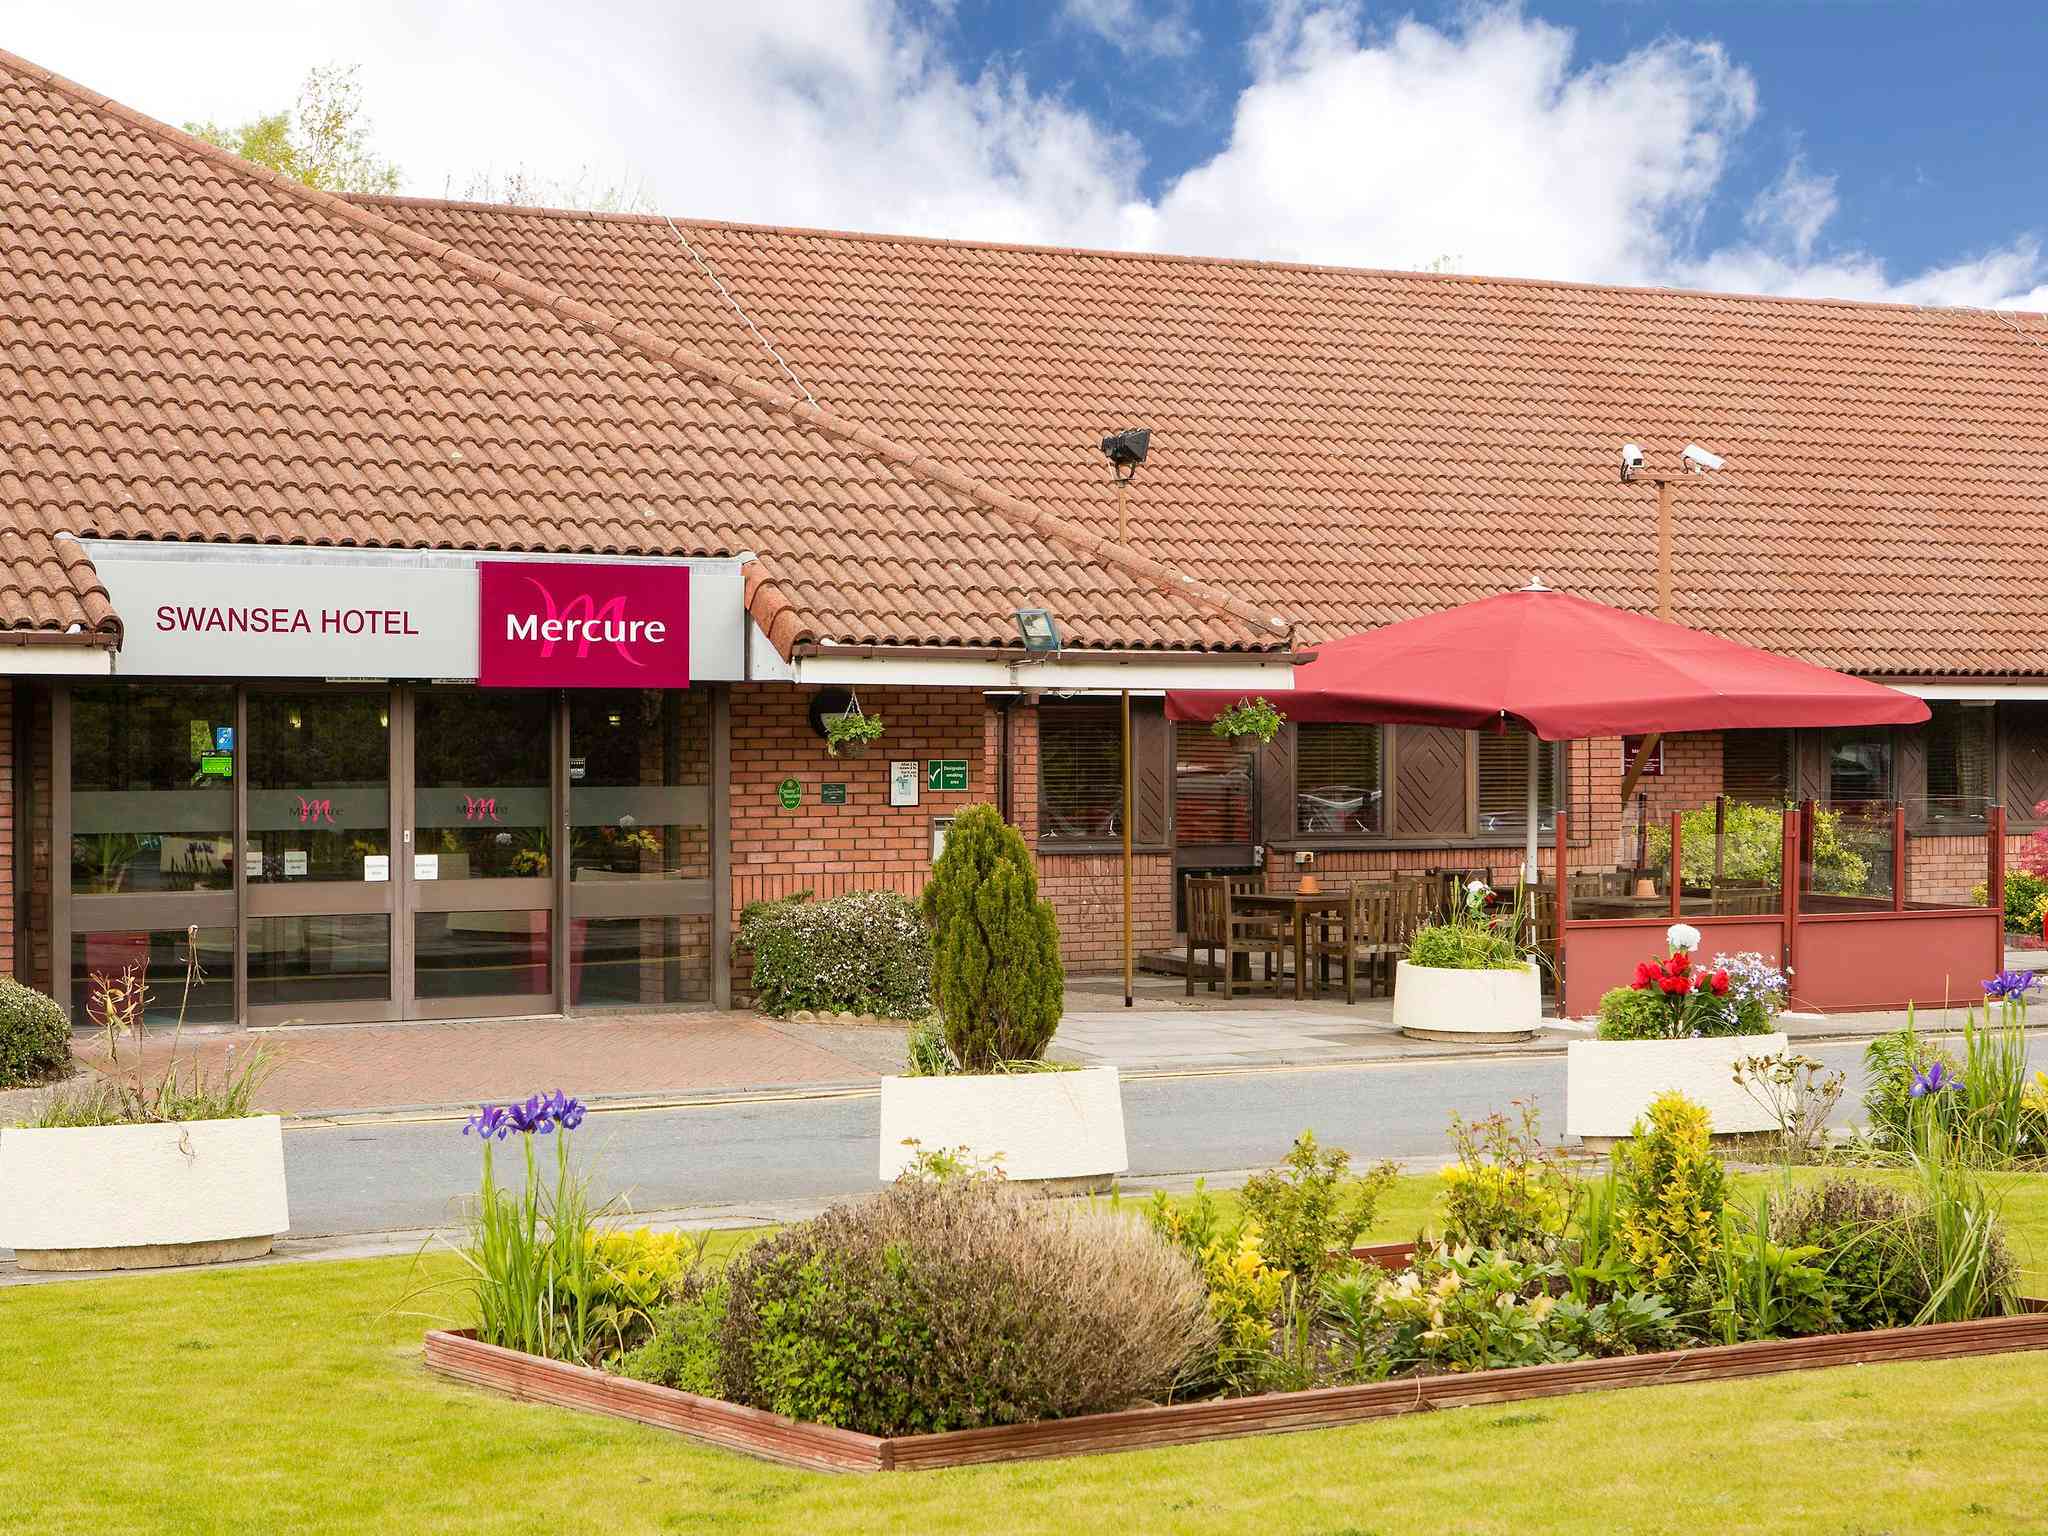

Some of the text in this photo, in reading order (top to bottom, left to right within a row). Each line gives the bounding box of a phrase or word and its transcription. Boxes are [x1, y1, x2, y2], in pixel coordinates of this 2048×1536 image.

[156, 605, 419, 635] SWANSEA HOTEL
[506, 613, 666, 643] Mercure
